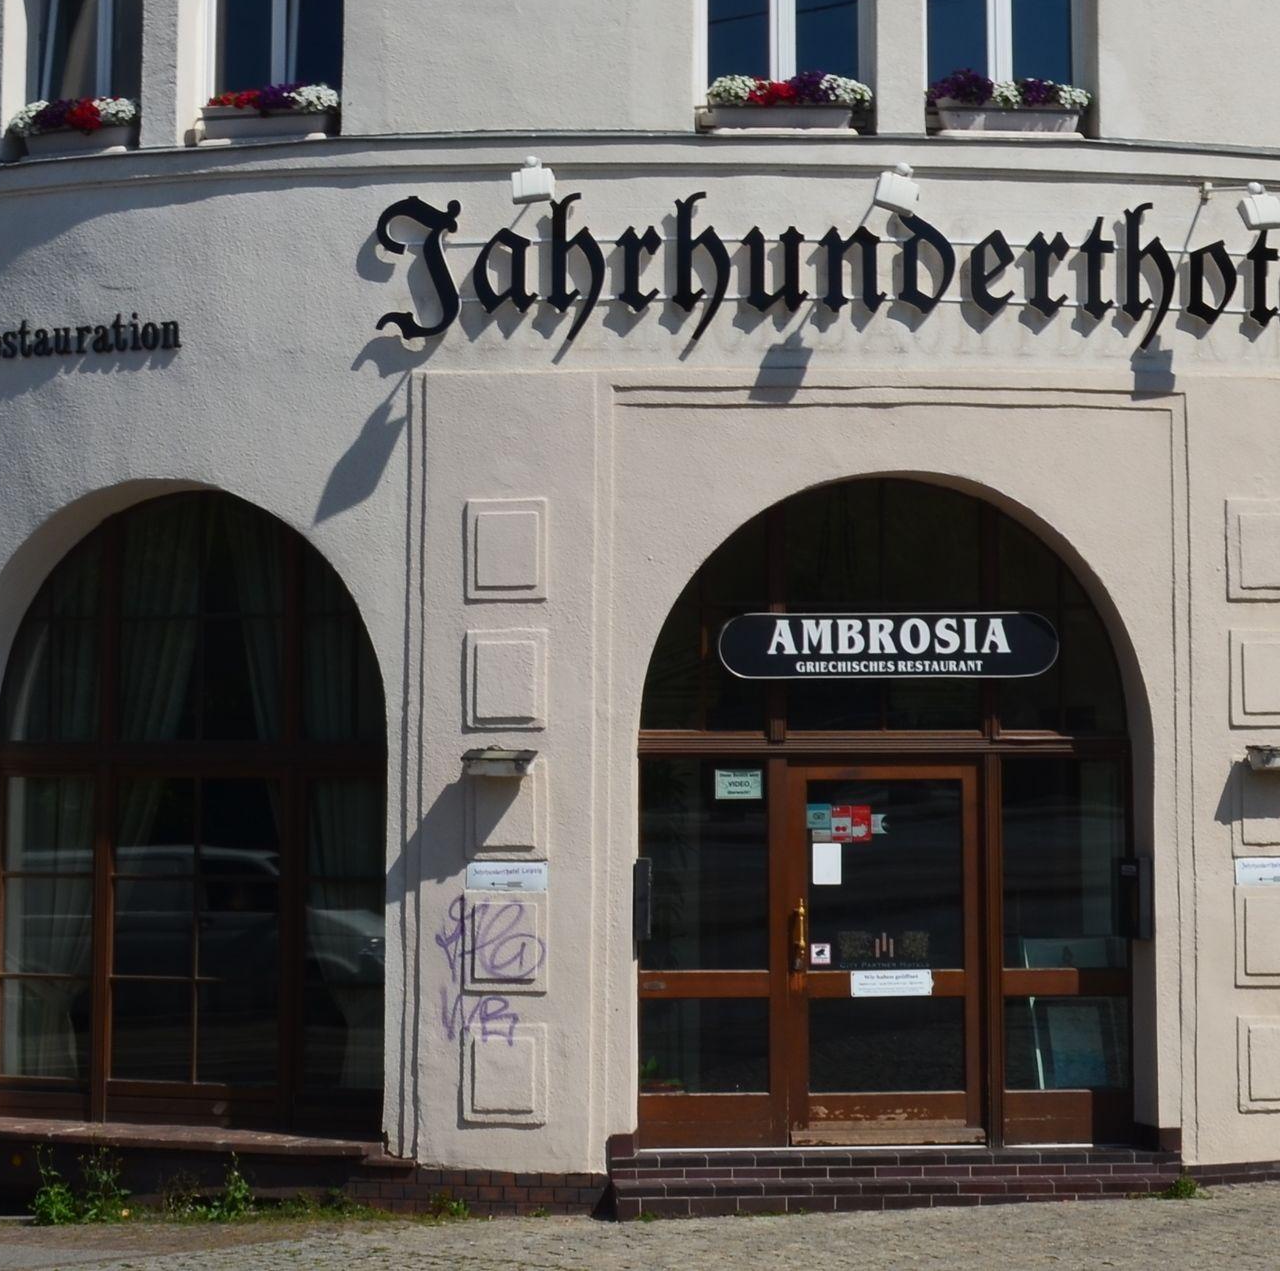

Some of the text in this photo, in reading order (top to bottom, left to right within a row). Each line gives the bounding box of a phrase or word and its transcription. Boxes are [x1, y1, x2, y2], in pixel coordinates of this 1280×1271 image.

[767, 618, 1011, 656] AMBROSIA
[796, 659, 983, 673] GRIECHISCHES RESTAURANT
